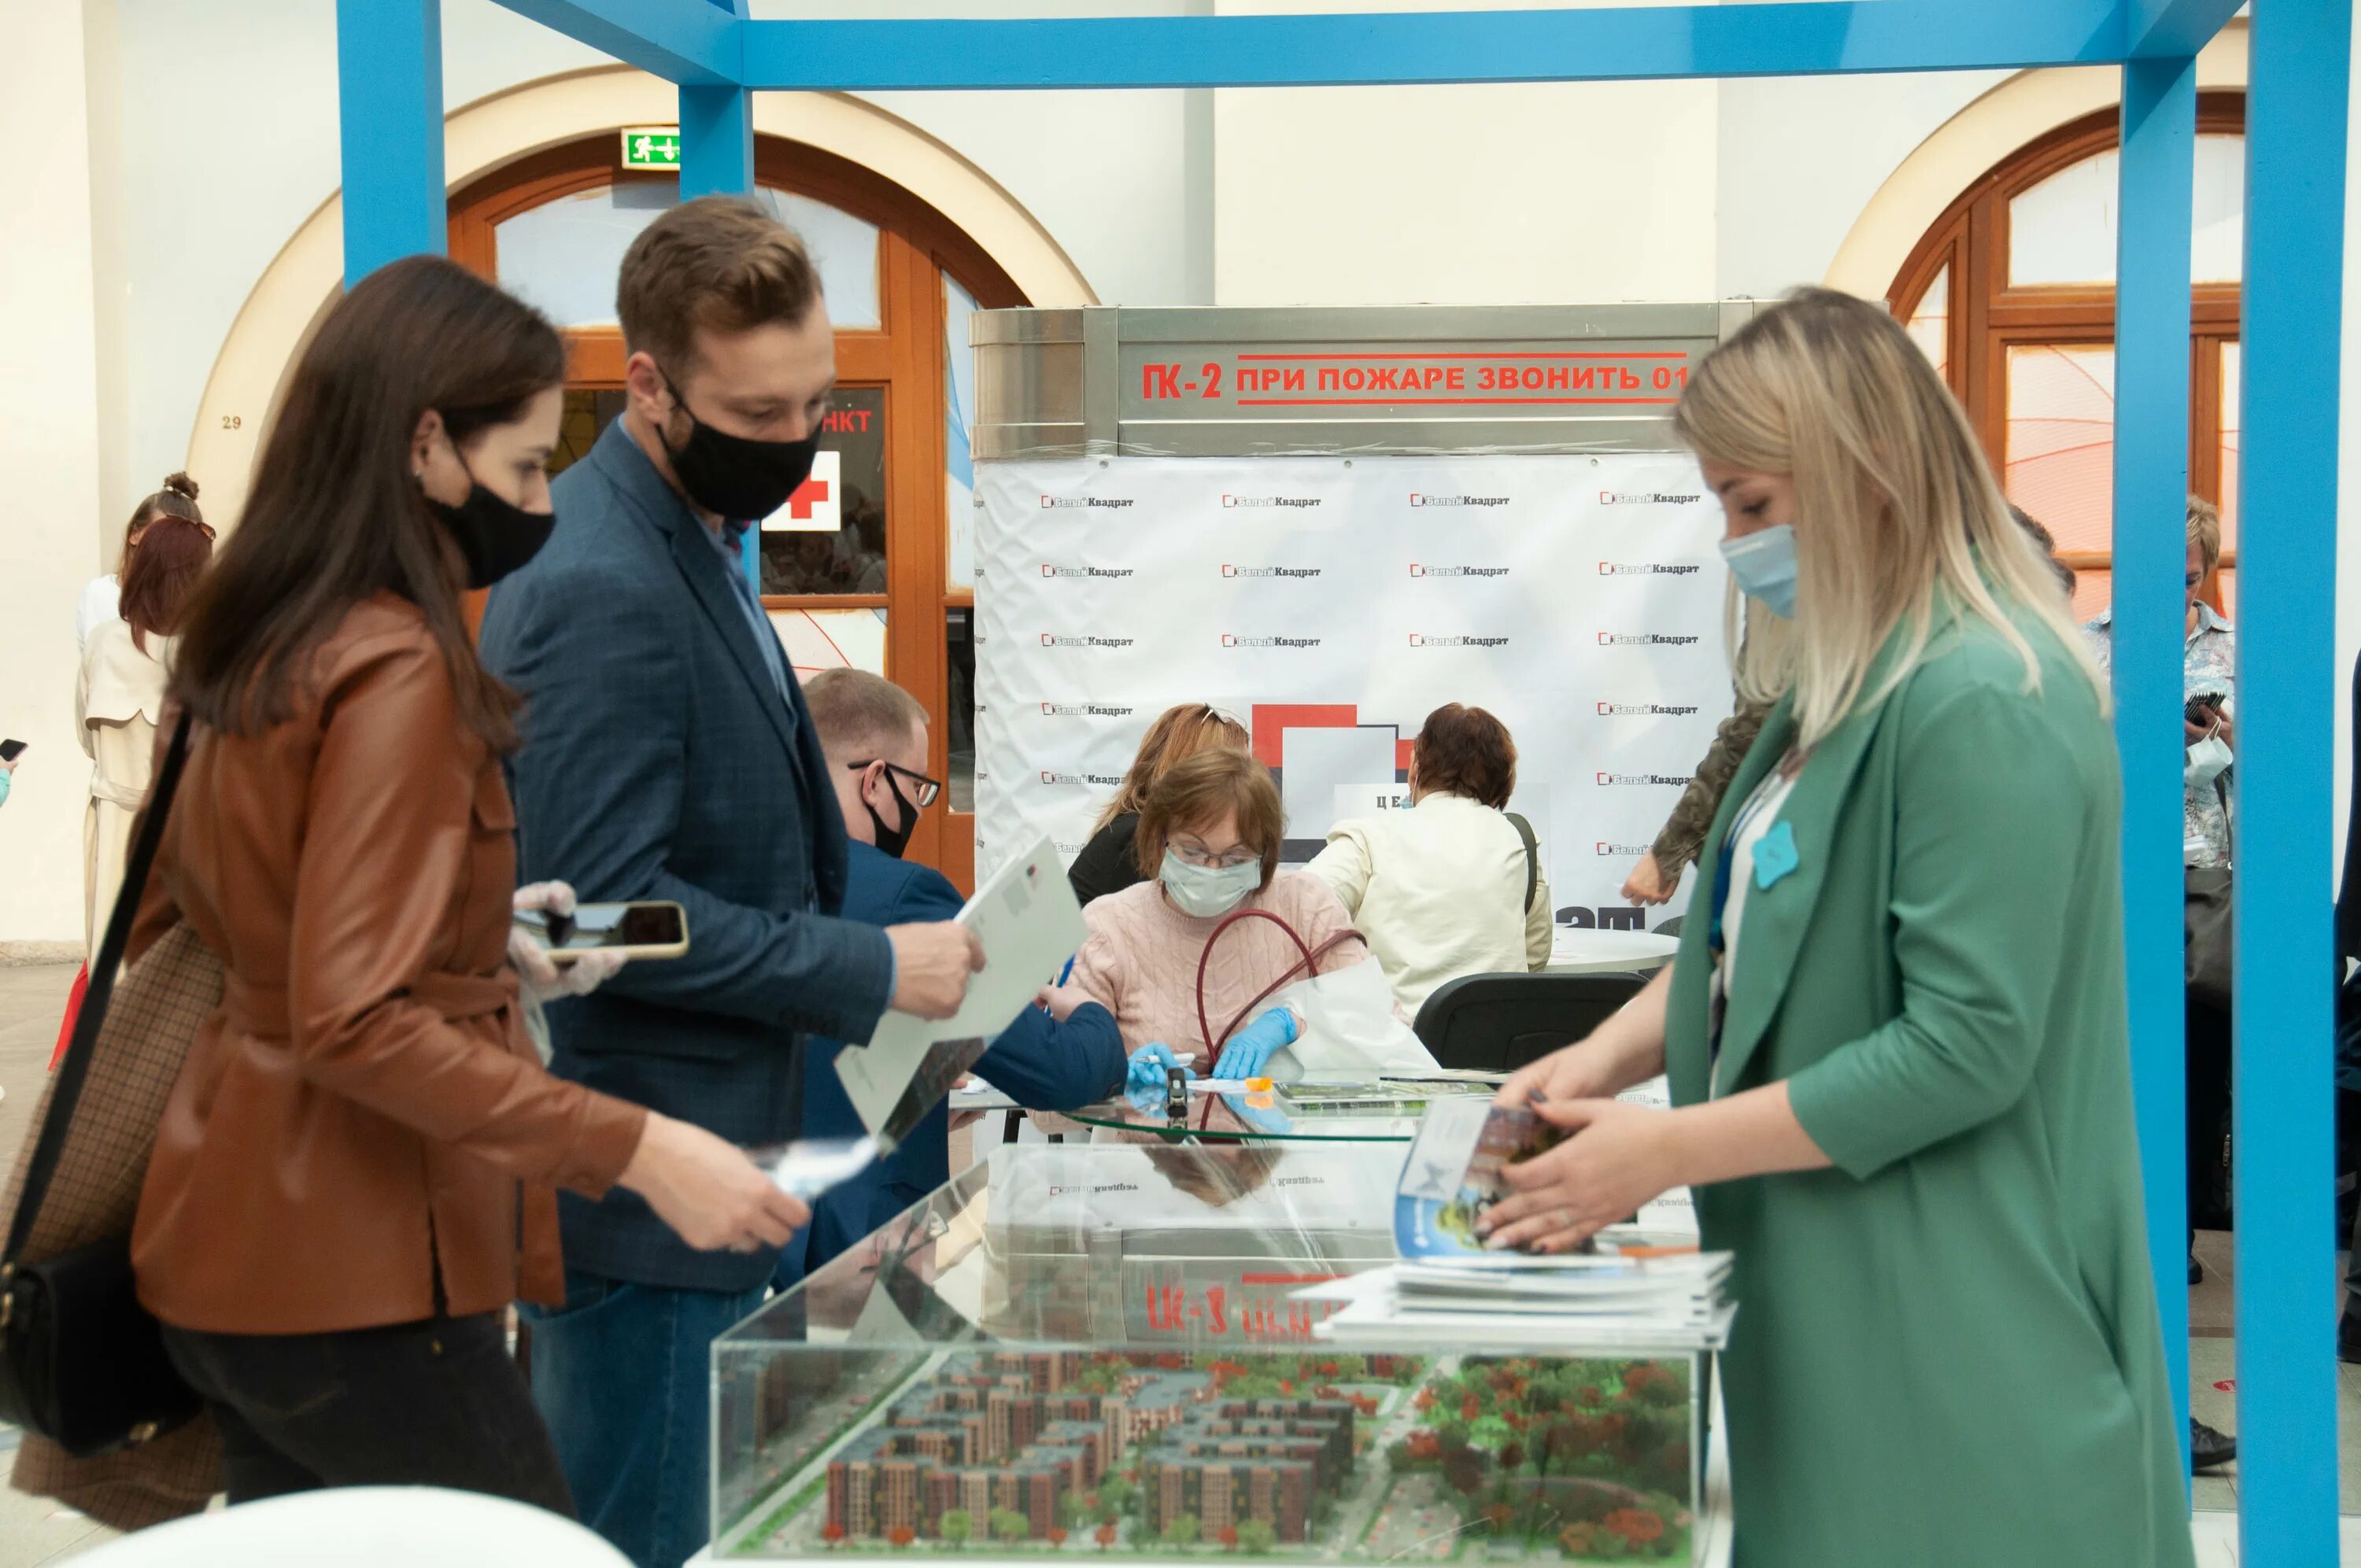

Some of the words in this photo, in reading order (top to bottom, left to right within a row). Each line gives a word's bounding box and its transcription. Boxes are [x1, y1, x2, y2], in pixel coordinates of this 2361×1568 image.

[1143, 363, 1221, 399] ПК-2
[1236, 369, 1304, 391] ПРИ
[1318, 367, 1465, 390] ПОЖАРЕ
[1476, 367, 1640, 390] ЗВОНИТЬ
[222, 415, 241, 430] 29
[822, 410, 873, 434] НКТ
[1376, 795, 1401, 810] ЦЕ
